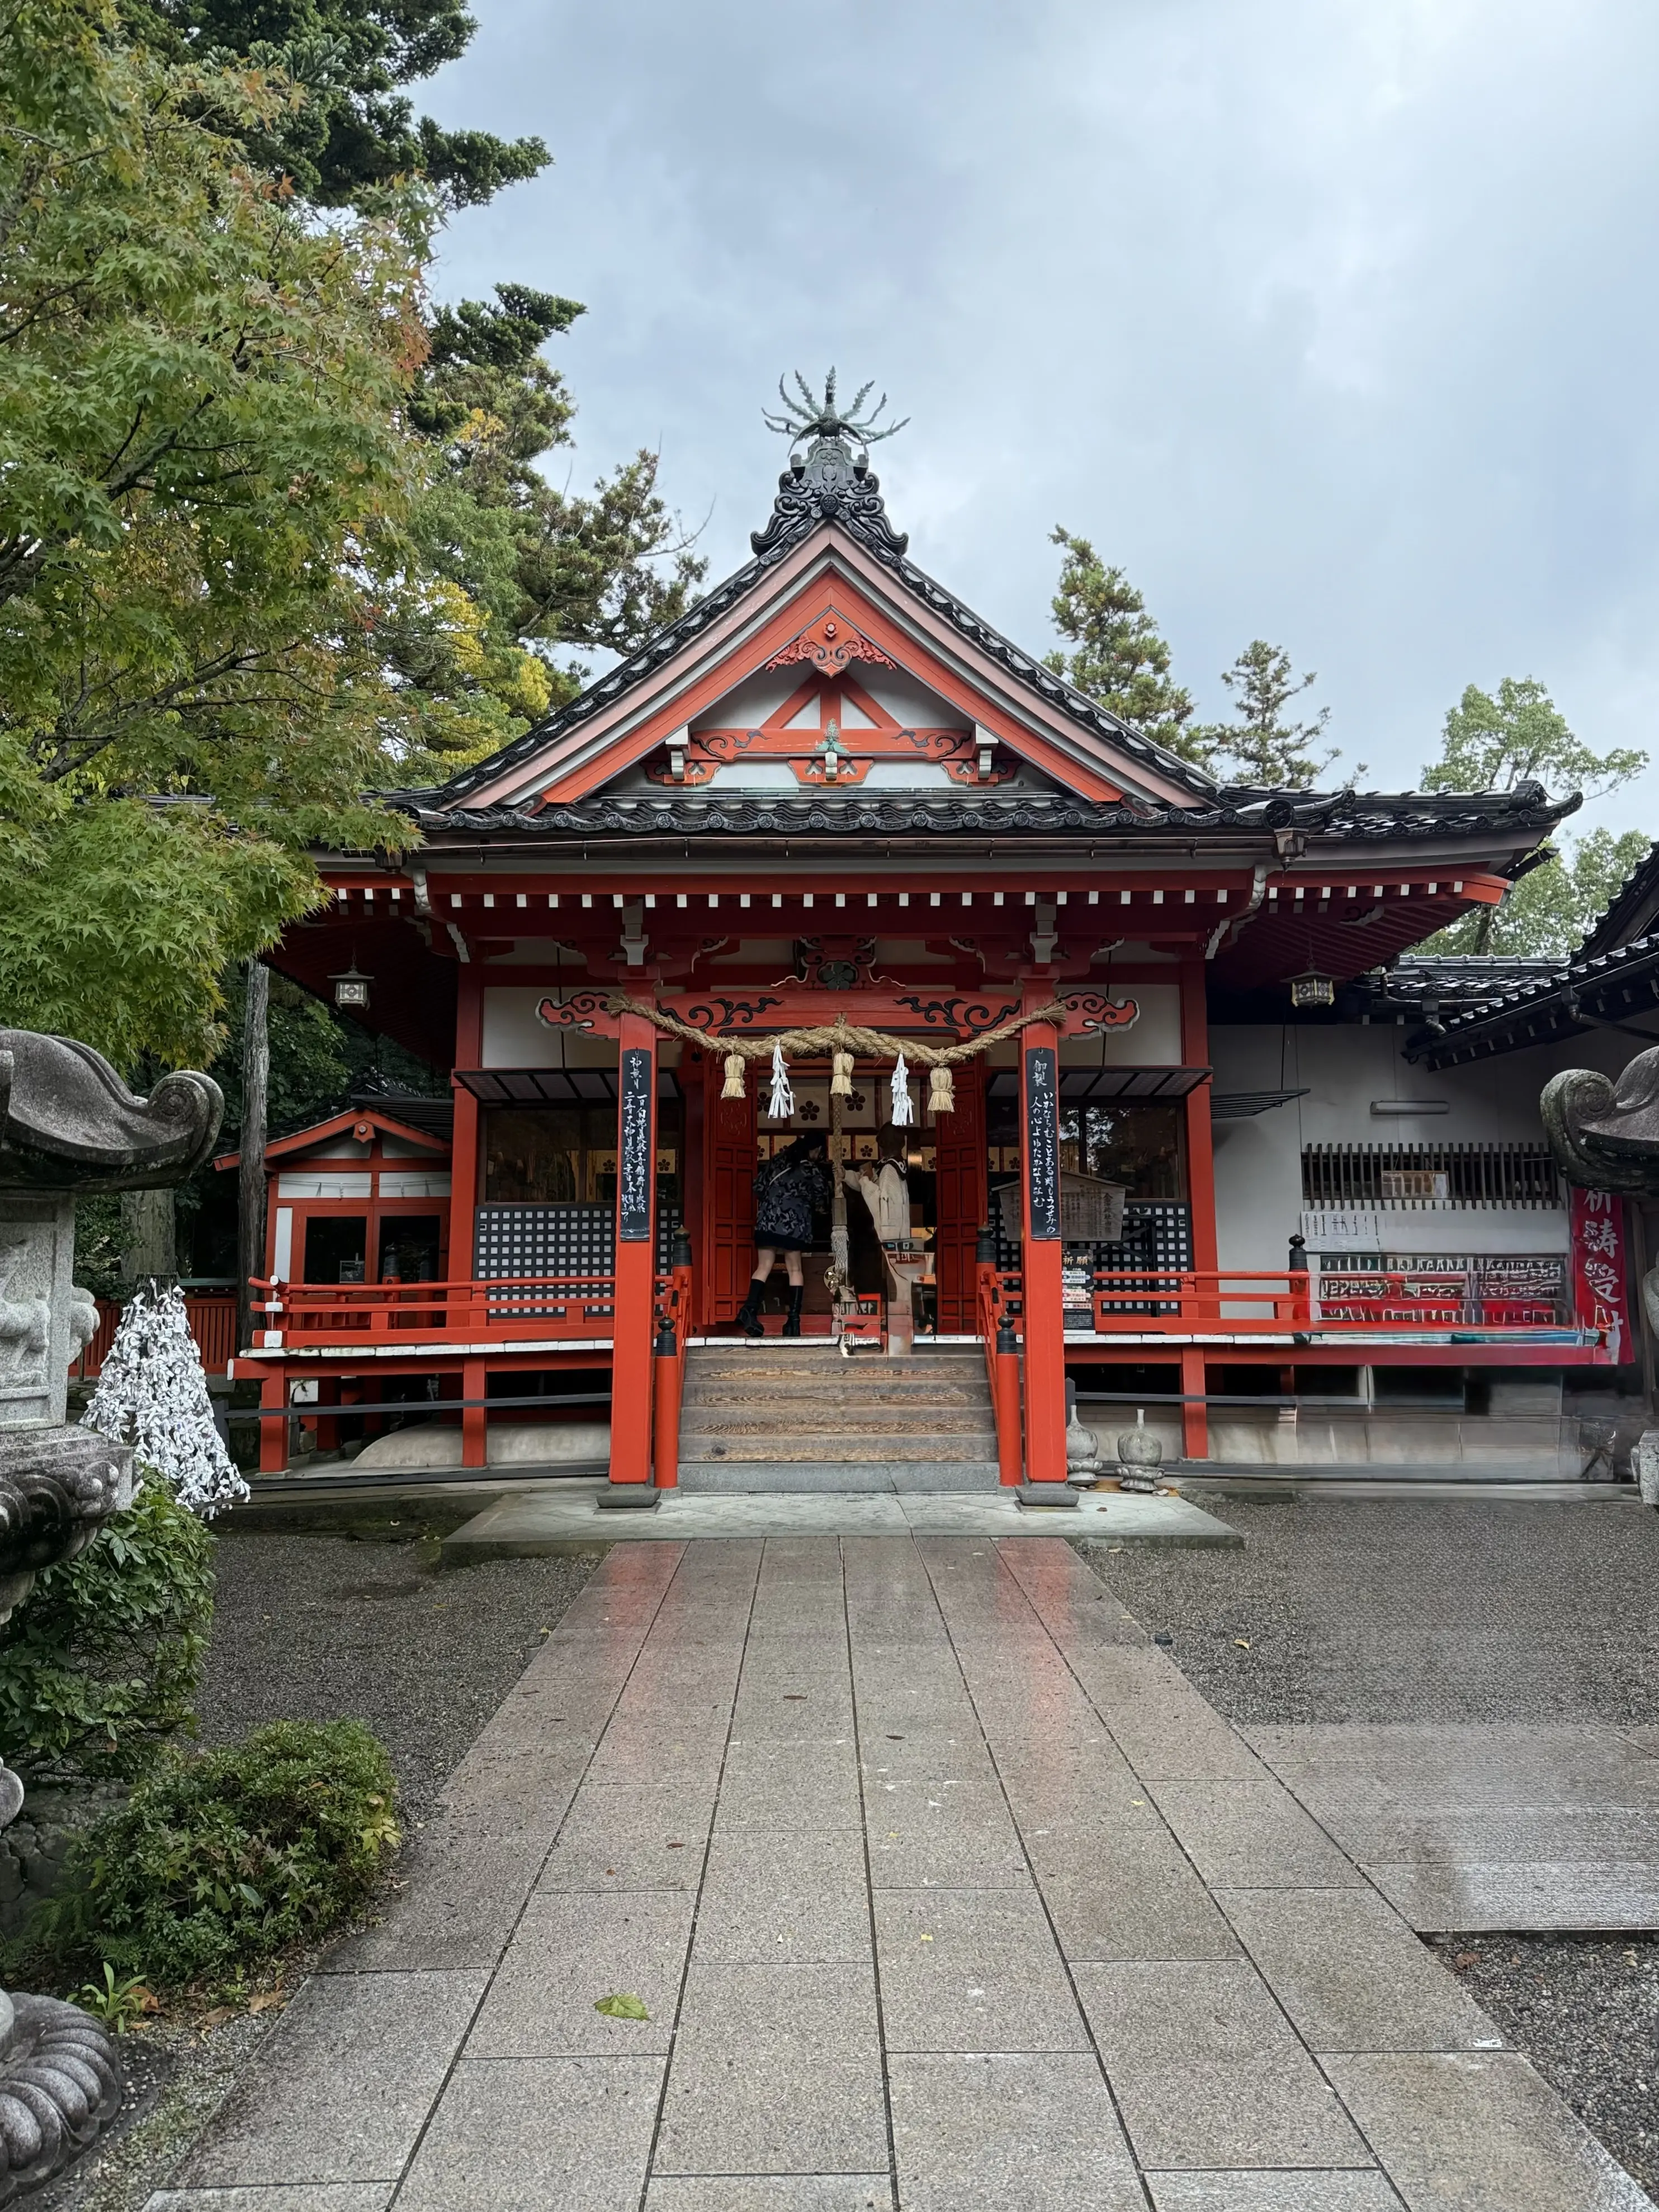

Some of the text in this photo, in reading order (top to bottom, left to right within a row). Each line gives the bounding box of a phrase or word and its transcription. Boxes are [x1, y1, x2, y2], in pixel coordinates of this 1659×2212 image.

[1032, 1060, 1047, 1087] 御製
[1029, 1096, 1045, 1208] 人の心よゆたかならなむ
[1062, 1255, 1088, 1266] 祈願
